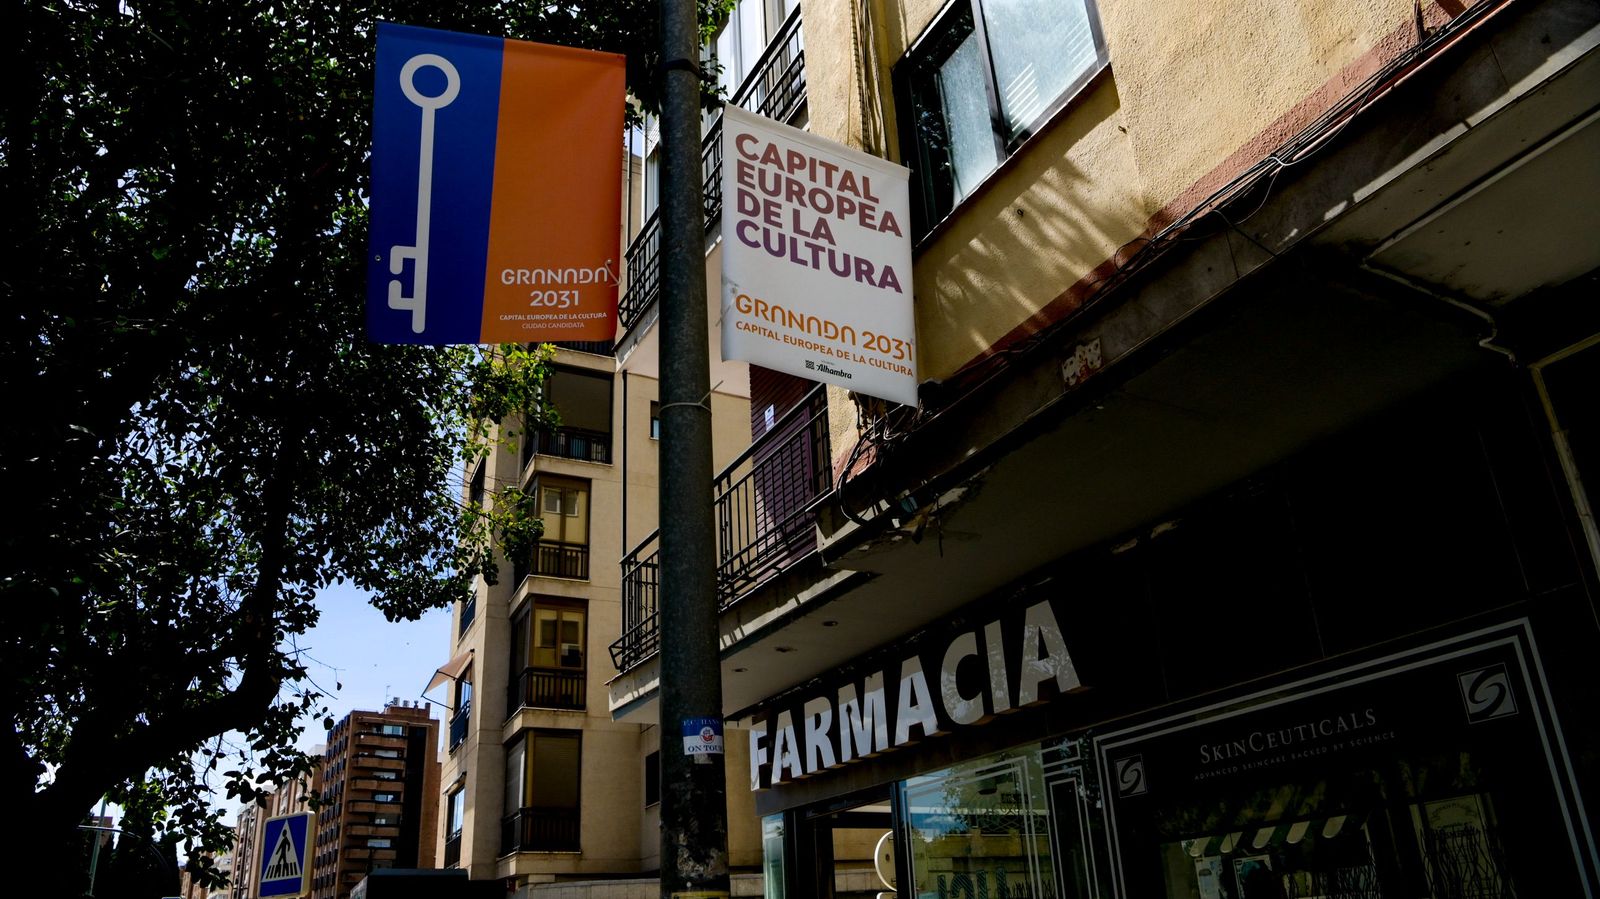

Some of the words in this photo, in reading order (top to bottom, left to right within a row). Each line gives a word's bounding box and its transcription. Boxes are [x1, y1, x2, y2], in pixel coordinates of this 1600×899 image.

[735, 133, 880, 204] CAPITAL
[736, 159, 903, 238] EUROPEA
[737, 187, 783, 229] DE
[792, 208, 837, 246] LA
[501, 267, 608, 285] GRANADA
[736, 219, 903, 294] CULTURA
[530, 290, 579, 308] 2031
[735, 293, 857, 346] GRANADA
[862, 331, 913, 362] 2031
[735, 320, 781, 342] CAPITAL
[783, 335, 834, 356] EUROPEA
[836, 350, 850, 361] DE
[852, 353, 866, 365] LA
[868, 357, 914, 378] CULTURA
[815, 363, 852, 379] Alhambra
[749, 599, 1082, 792] FARMACIA
[1194, 766, 1238, 781] ADVANCED
[1243, 755, 1287, 771] SKINCARE
[1291, 746, 1328, 761] BACKED
[1349, 731, 1395, 747] SCIENCE
